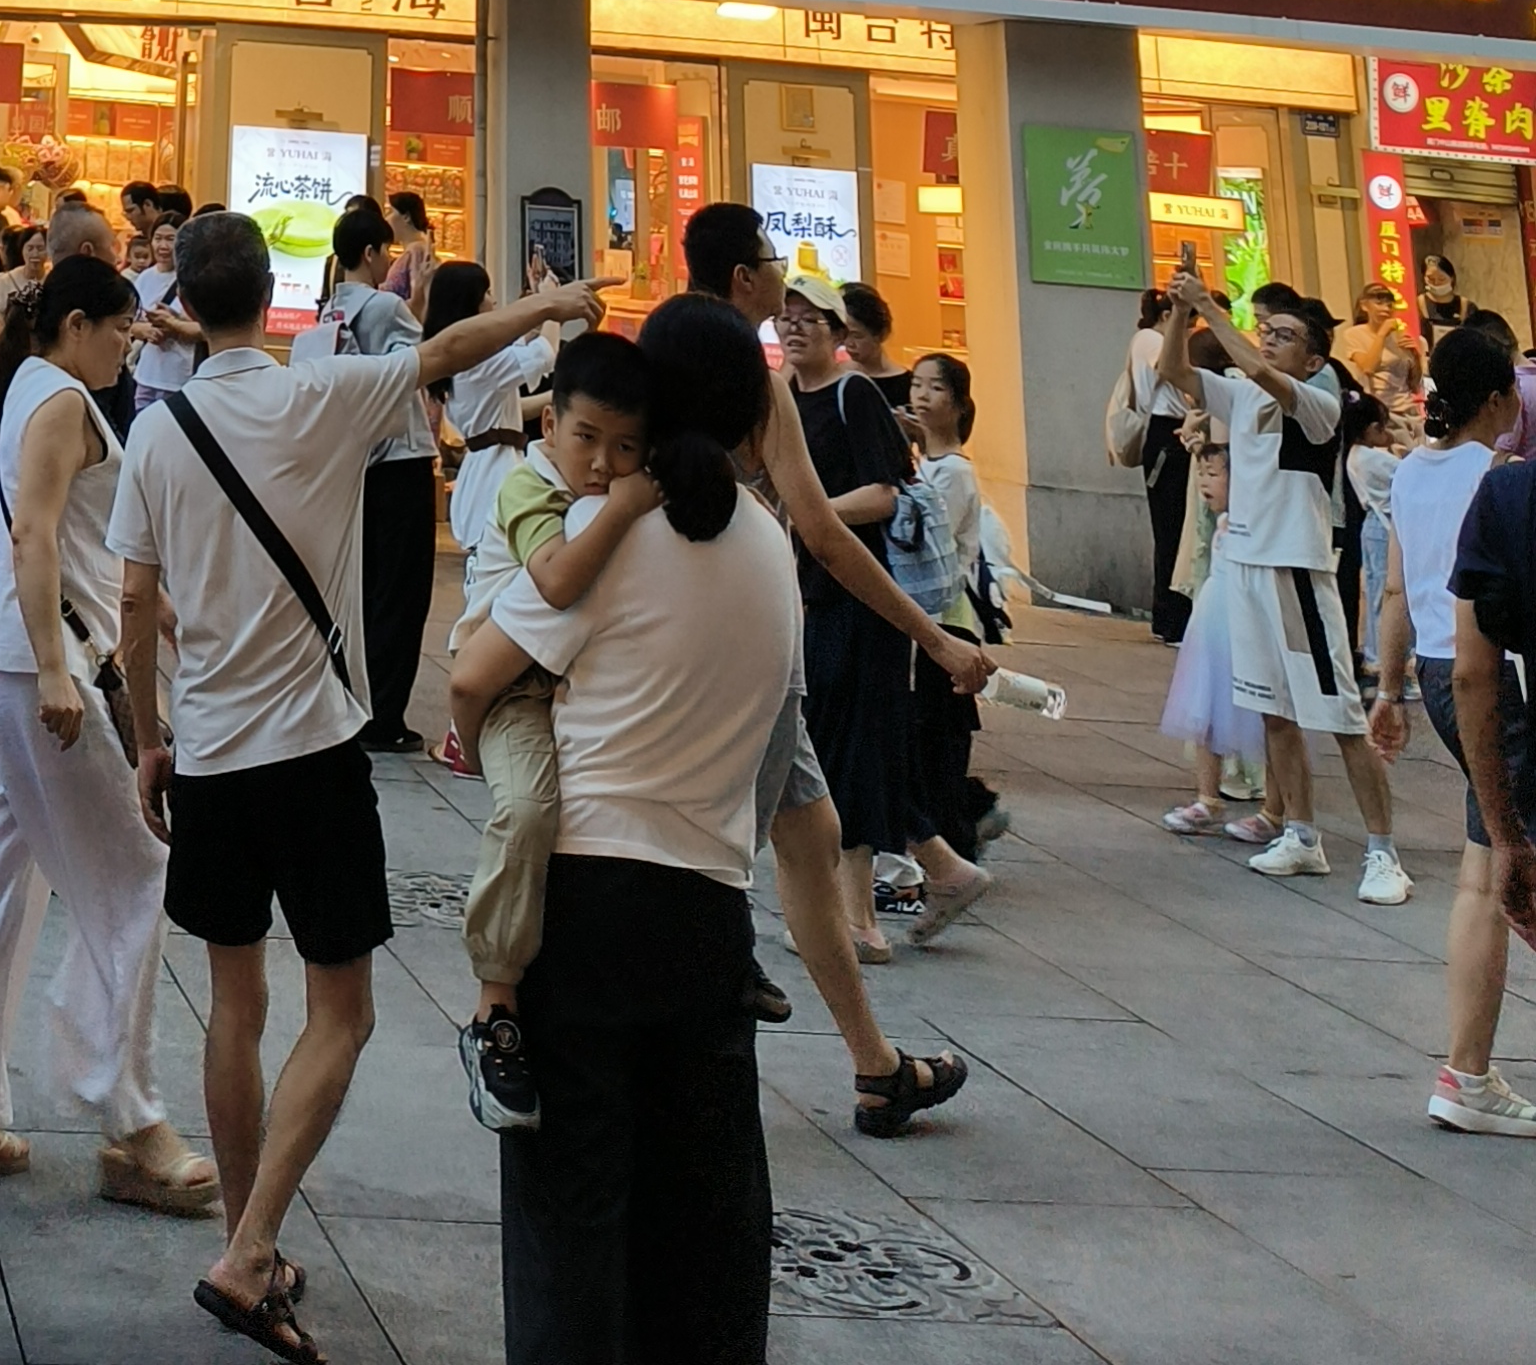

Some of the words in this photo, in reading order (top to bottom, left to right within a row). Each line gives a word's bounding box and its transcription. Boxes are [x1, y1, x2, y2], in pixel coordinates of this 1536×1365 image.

[596, 103, 622, 133] 邮
[1421, 96, 1533, 140] 里脊肉
[280, 149, 318, 161] YUHAI
[248, 172, 353, 206] 流心茶饼
[786, 187, 825, 199] YUHAI
[765, 211, 857, 240] 凤梨酥
[1177, 204, 1215, 218] YUHAI
